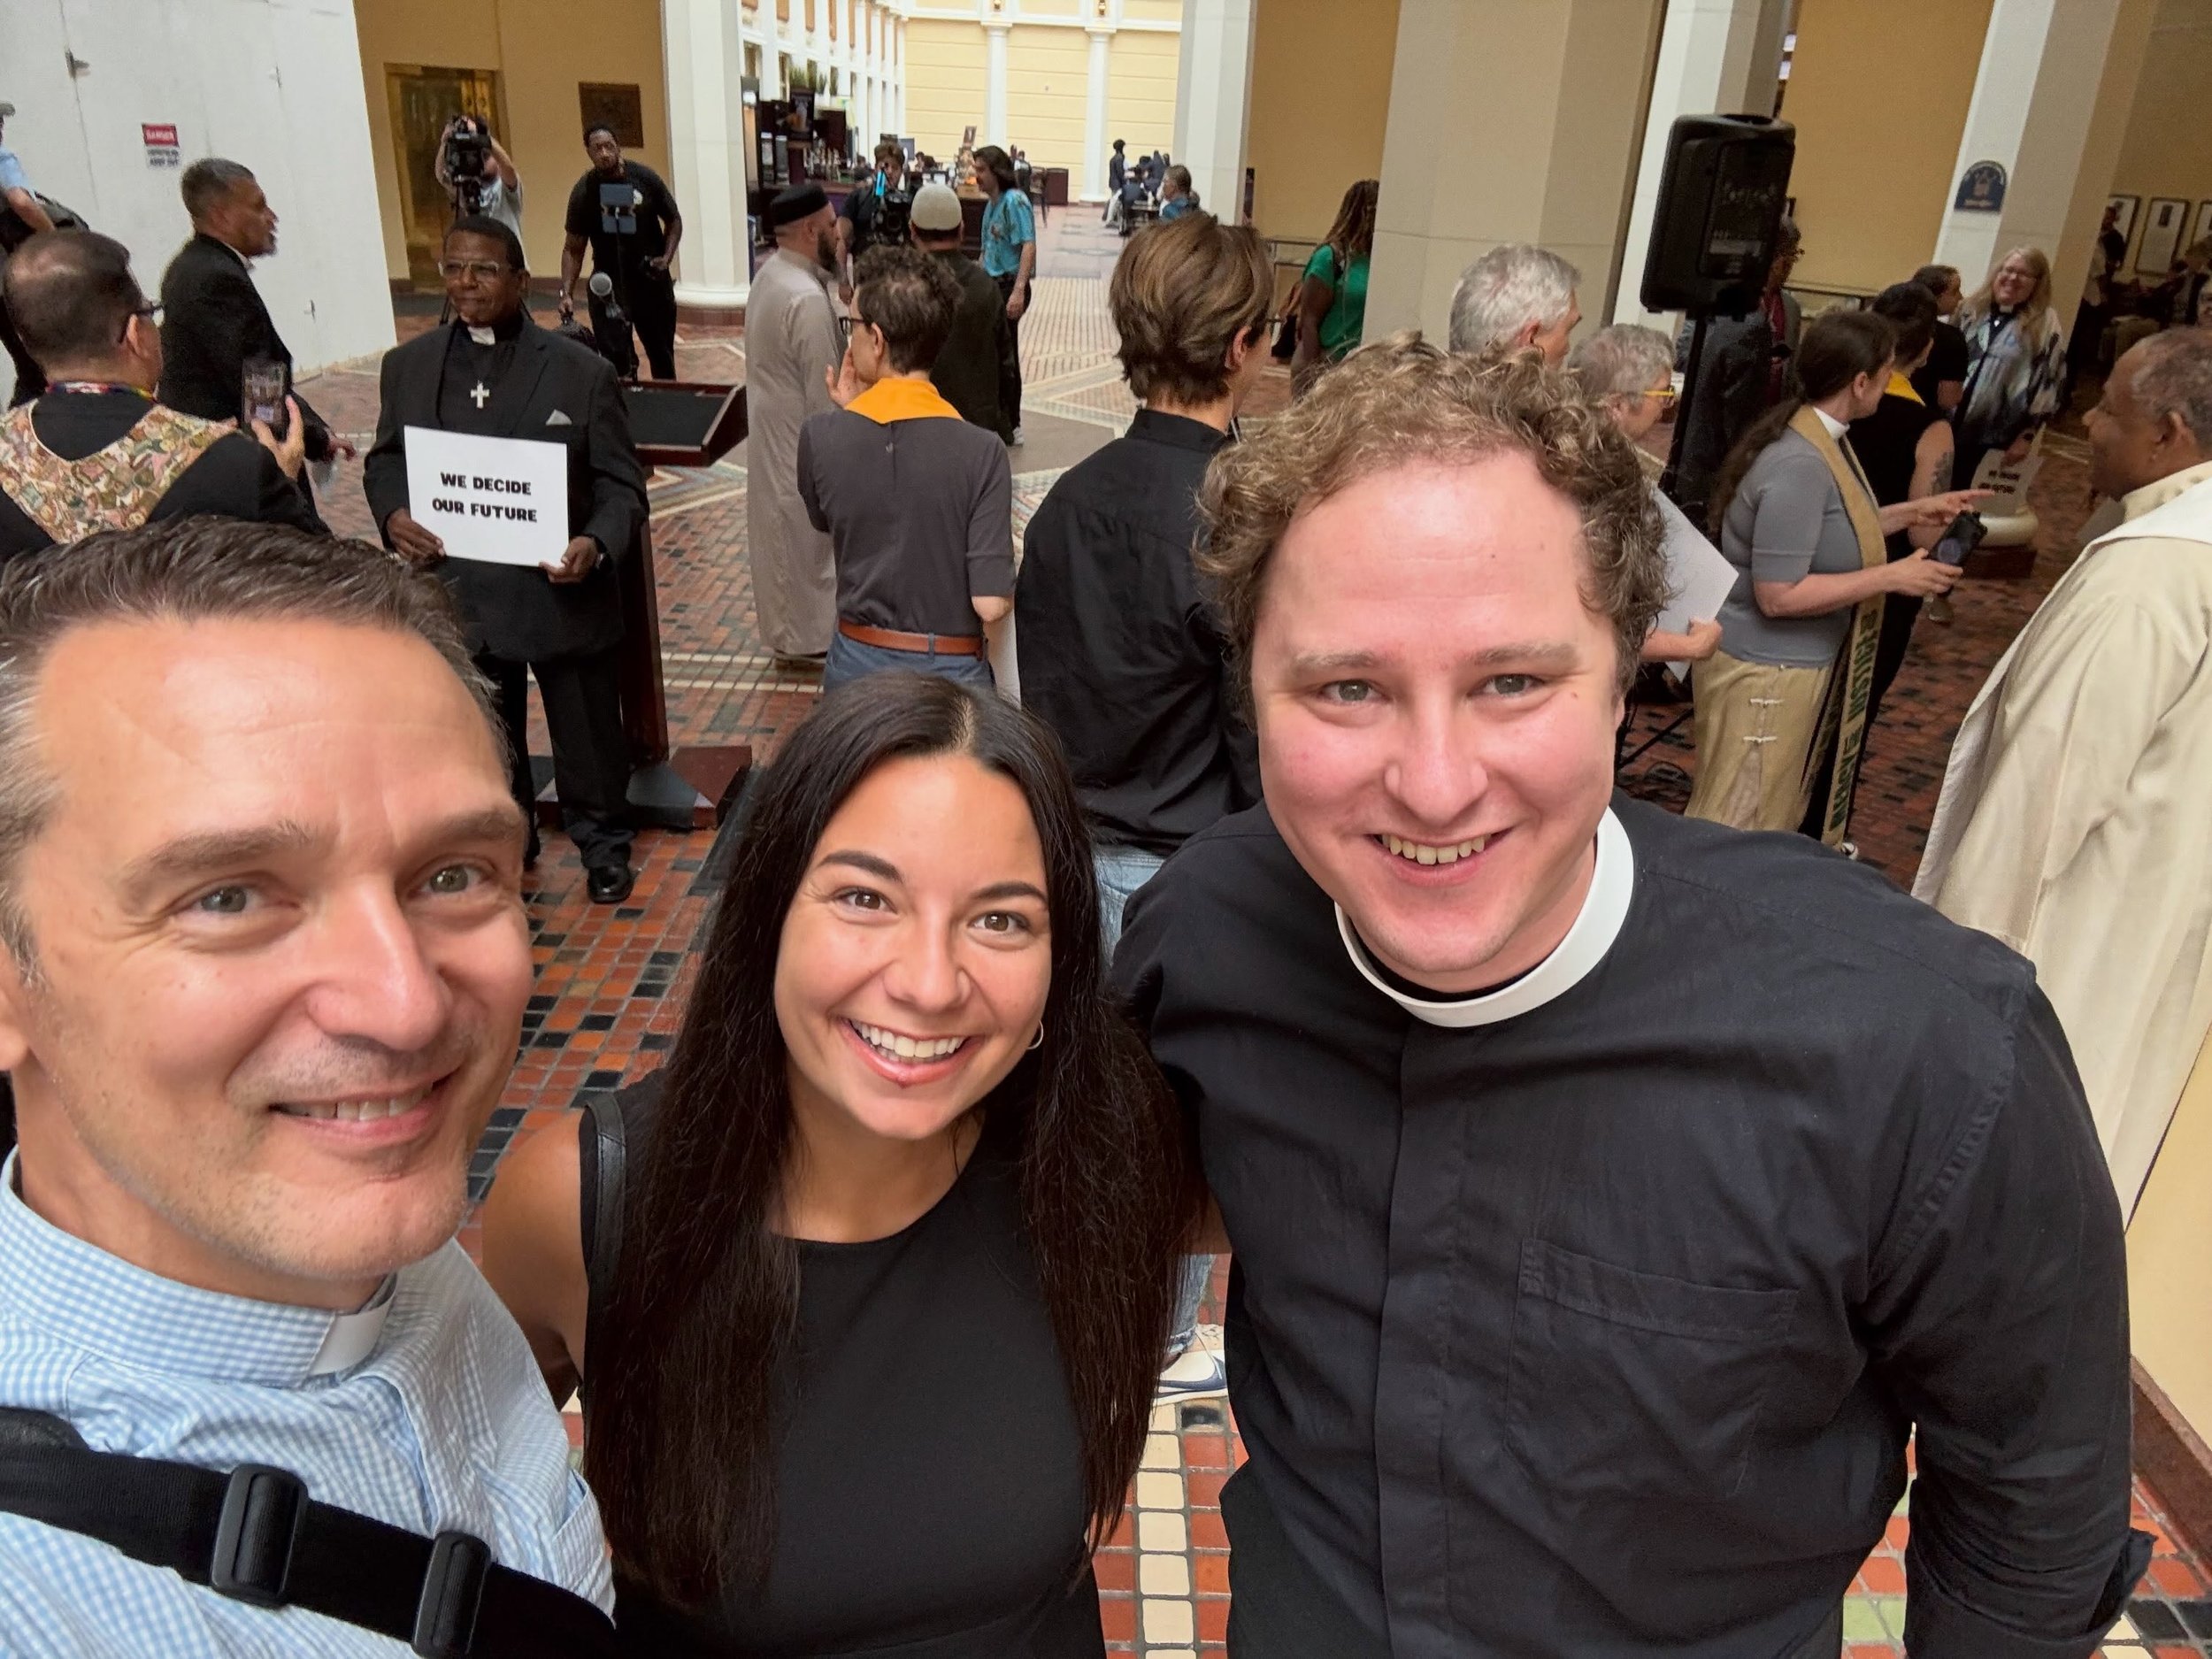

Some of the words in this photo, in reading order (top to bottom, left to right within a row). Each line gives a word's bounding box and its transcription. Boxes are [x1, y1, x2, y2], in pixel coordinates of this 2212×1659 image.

[441, 472, 466, 488] WE
[472, 476, 532, 495] DECIDE
[432, 498, 465, 514] OUR
[471, 503, 537, 522] FUTURE
